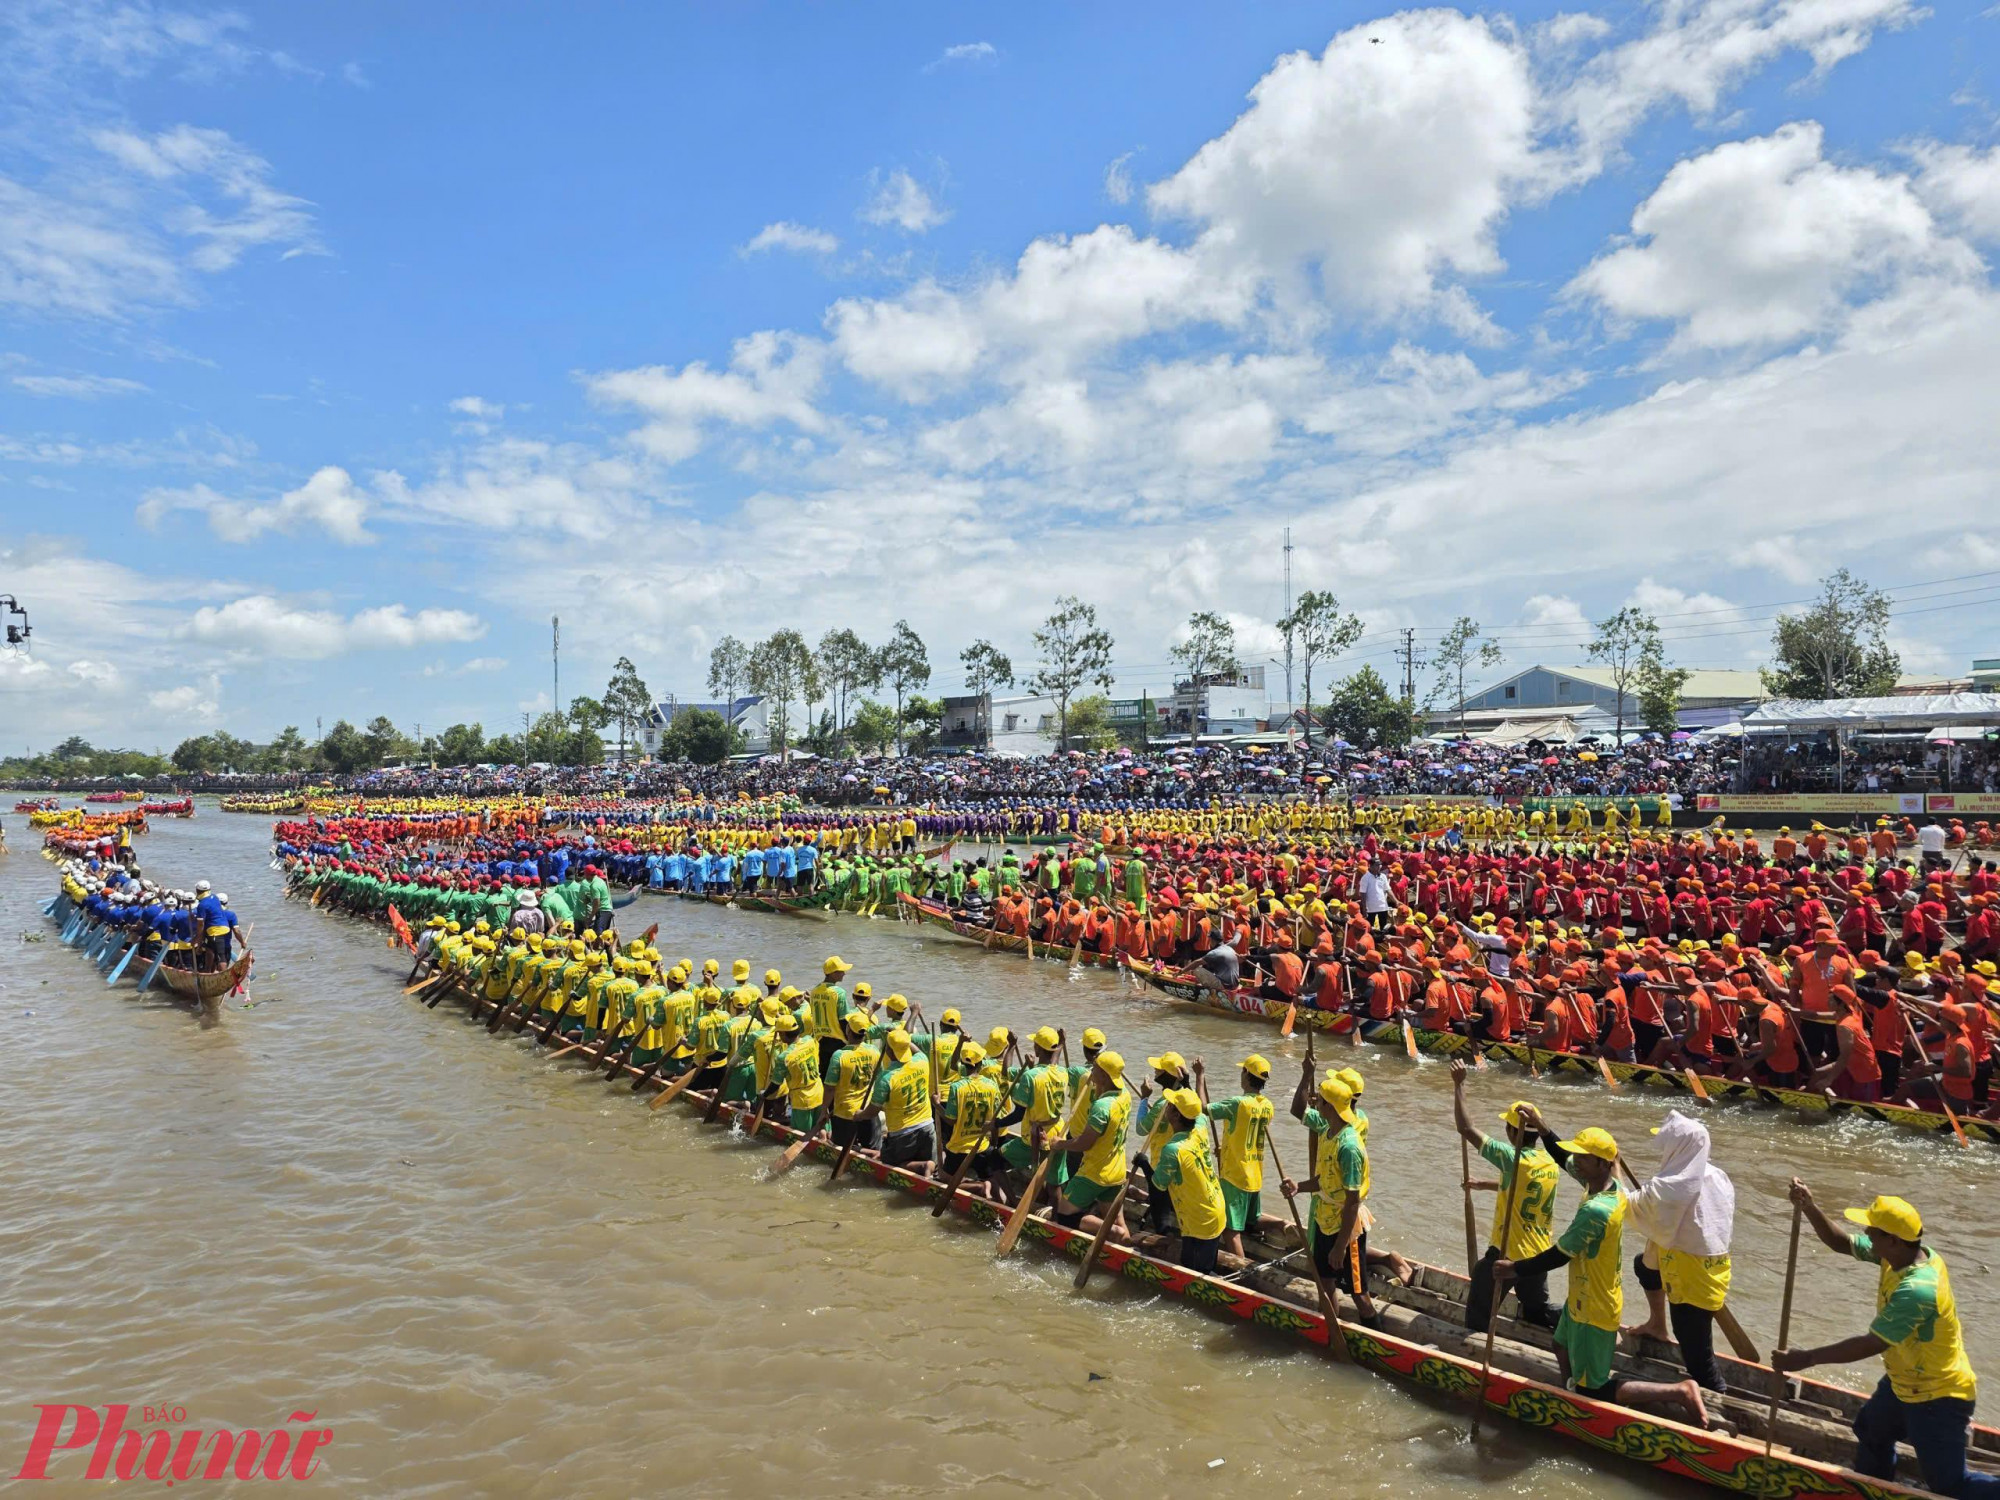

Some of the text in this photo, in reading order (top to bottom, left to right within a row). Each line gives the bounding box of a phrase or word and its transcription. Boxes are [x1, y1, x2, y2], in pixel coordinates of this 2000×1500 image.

[813, 1001, 829, 1026] 11
[1239, 996, 1262, 1014] 04
[1520, 1181, 1556, 1225] 24
